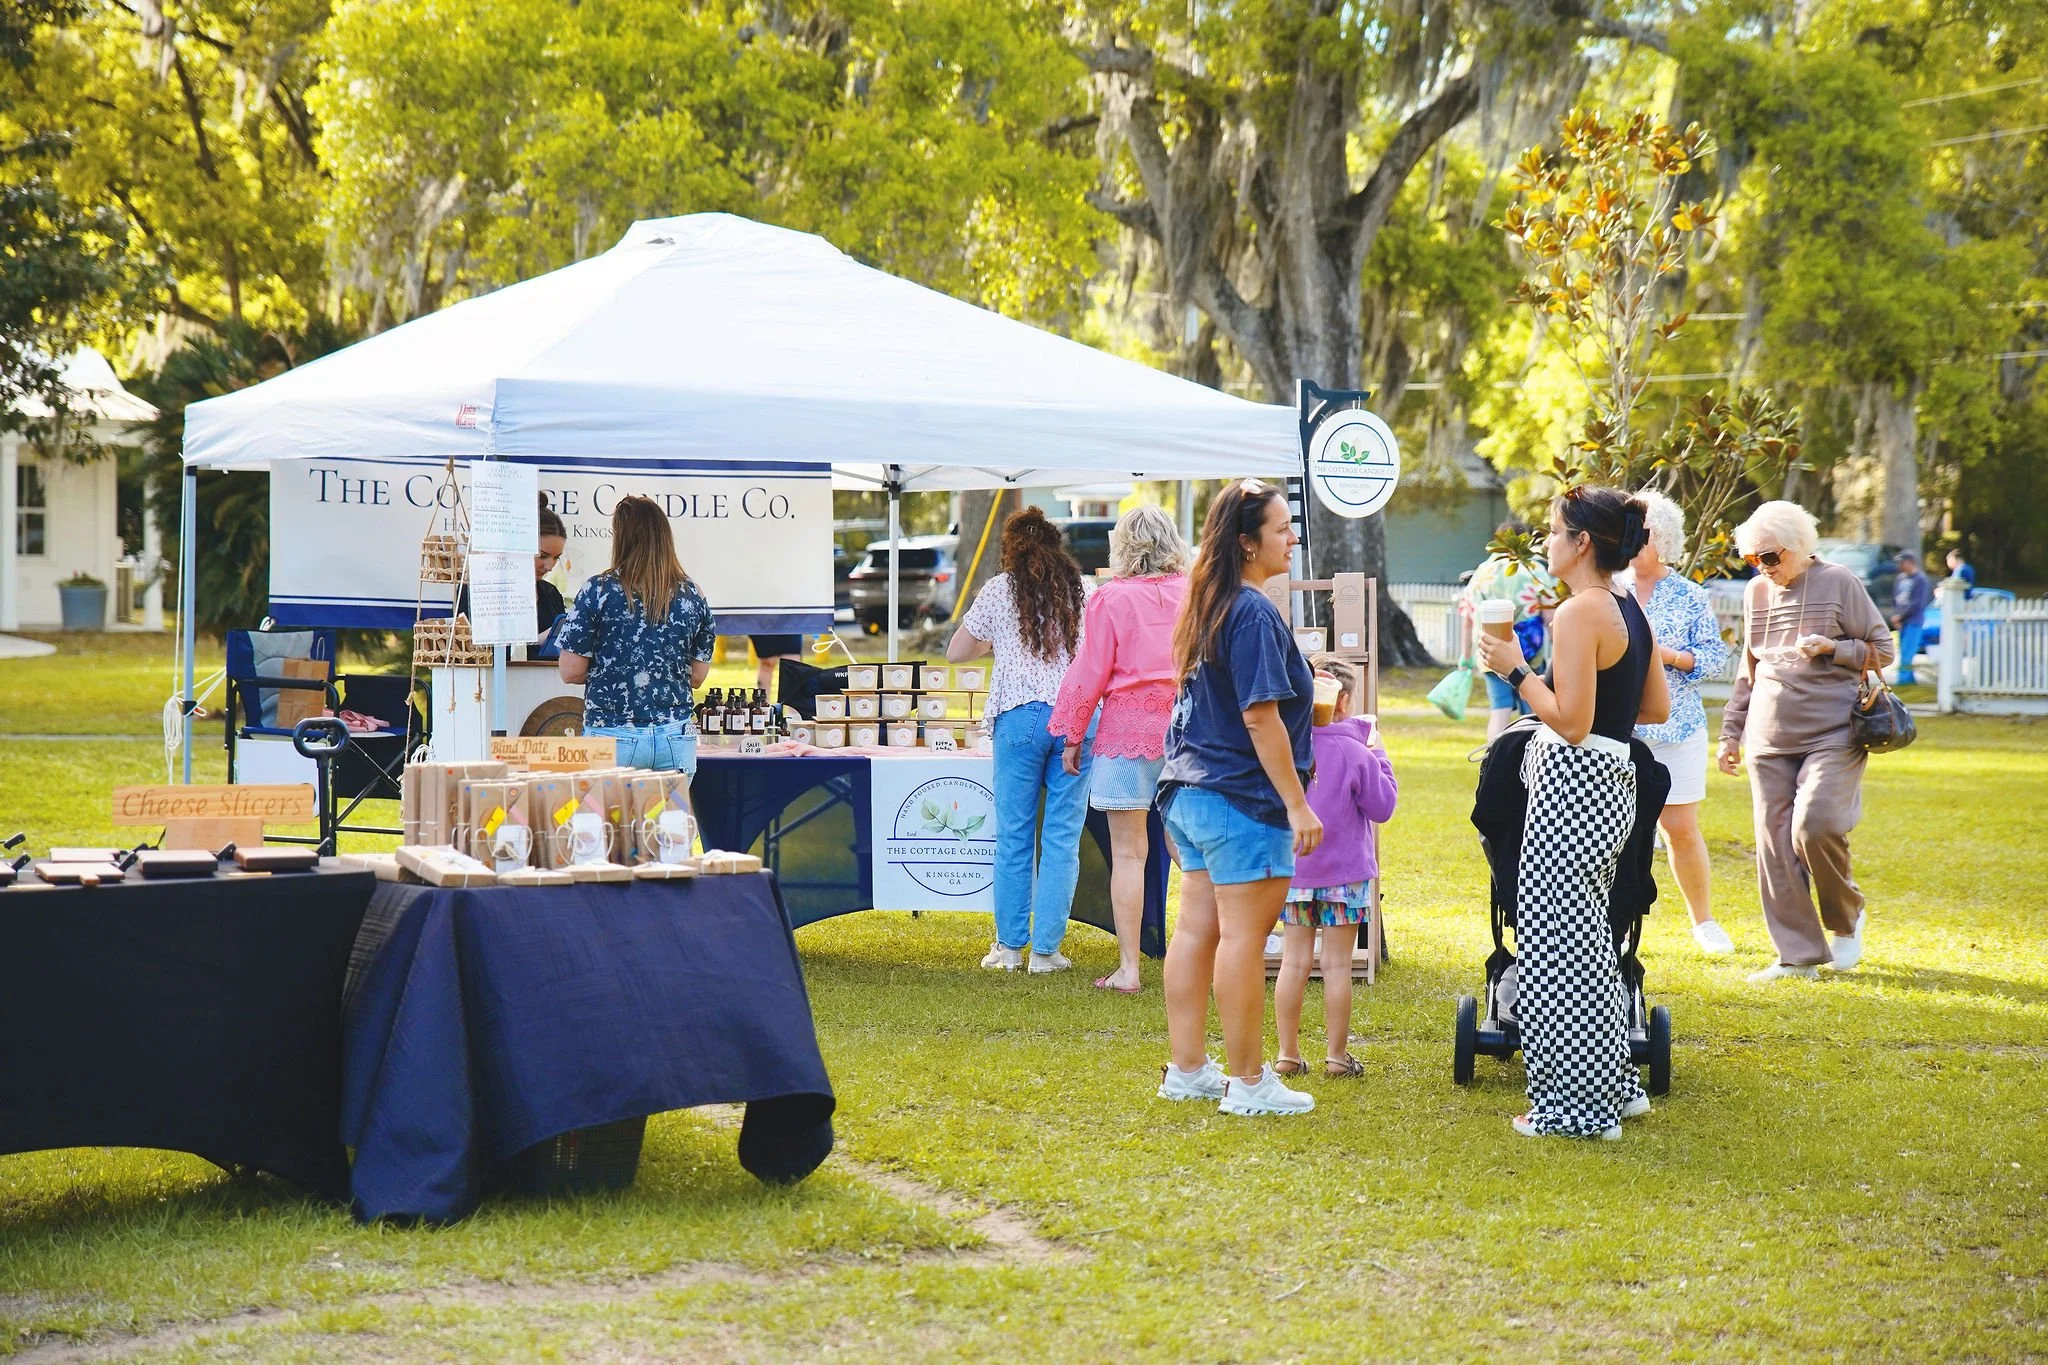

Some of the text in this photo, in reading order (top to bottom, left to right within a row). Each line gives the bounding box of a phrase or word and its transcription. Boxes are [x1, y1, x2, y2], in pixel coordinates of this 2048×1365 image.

[309, 467, 391, 505] THE
[491, 738, 549, 754] Blind Date
[122, 787, 305, 817] Cheese Slicers
[900, 780, 993, 819] HAND POURED CANDLES AND
[886, 847, 907, 855] THE
[909, 847, 957, 855] COTTAGE
[925, 871, 985, 879] KINGSLAND,
